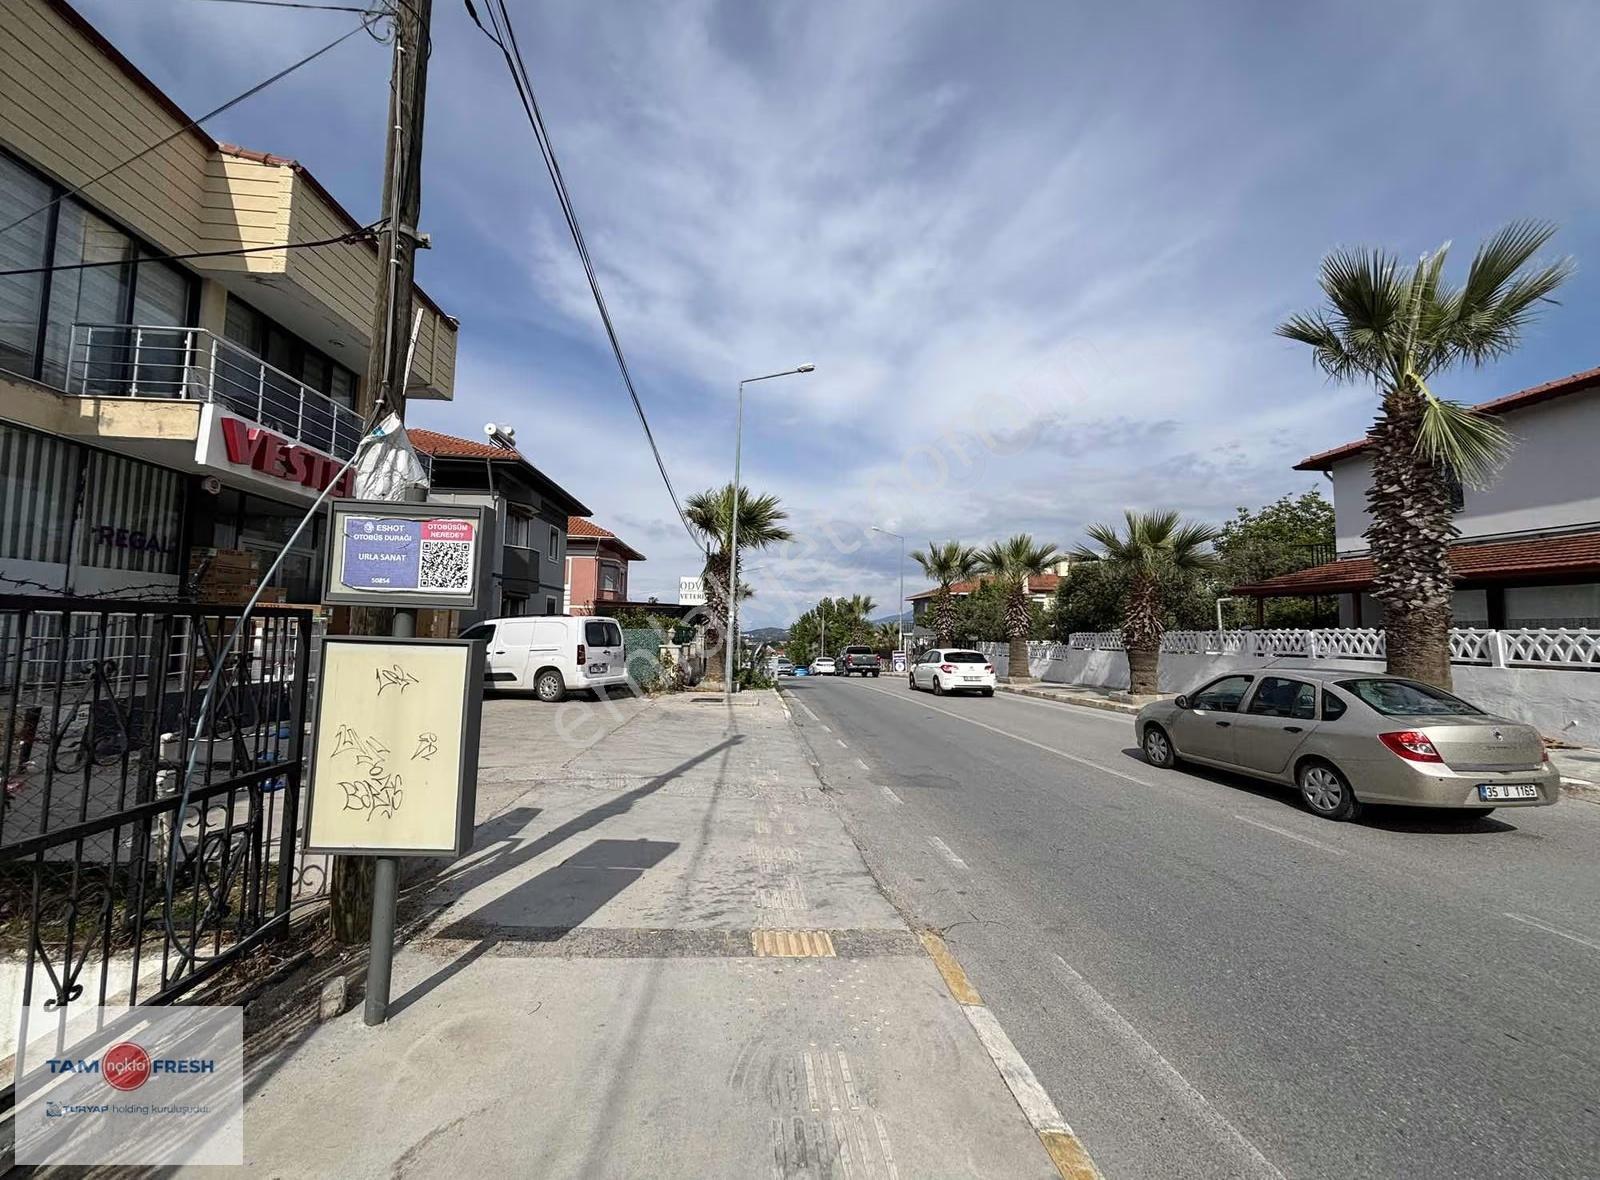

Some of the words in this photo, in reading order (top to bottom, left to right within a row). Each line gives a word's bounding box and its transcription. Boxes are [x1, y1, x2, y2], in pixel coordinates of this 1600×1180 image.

[376, 524, 406, 532] ESHOT
[353, 533, 384, 541] OTOBÜS
[384, 533, 412, 542] DURAĞI
[358, 553, 379, 561] URLA
[380, 553, 407, 562] SANAT
[1486, 786, 1498, 798] 35
